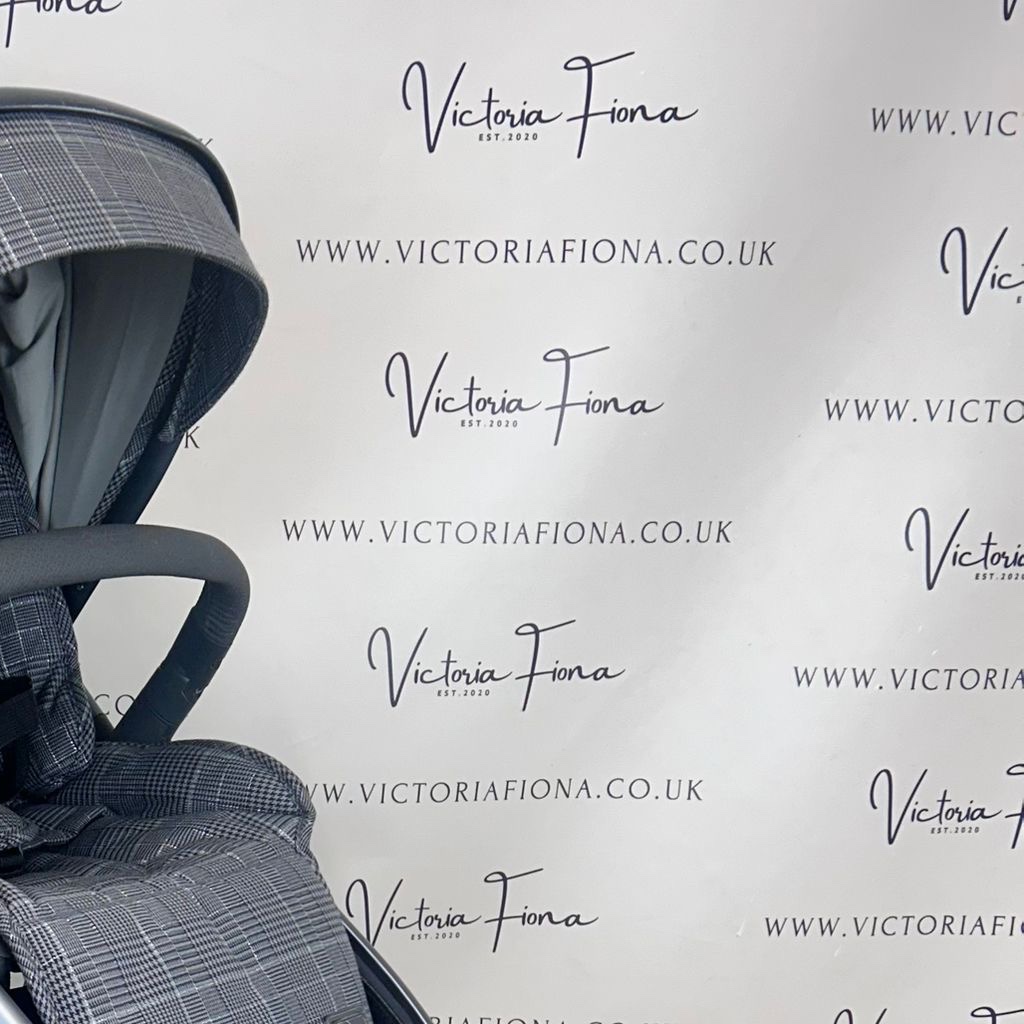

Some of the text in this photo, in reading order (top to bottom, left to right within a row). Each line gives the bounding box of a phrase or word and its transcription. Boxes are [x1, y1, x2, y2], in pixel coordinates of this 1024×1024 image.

[402, 51, 699, 159] Victoria Fiona
[479, 133, 538, 141] EST.2020
[296, 239, 777, 266] WWW.VICTORIAFIONA.CO.UK
[385, 346, 664, 446] Victoria Fiona
[461, 419, 517, 427] EST.2020
[282, 519, 732, 544] WWW.VICTORIAFIONA.CO.UK
[368, 619, 625, 712] Victoria Fiona
[870, 769, 1002, 845] Victoria
[346, 868, 599, 953] Victoria Fiona
[411, 932, 460, 940] EST.2020
